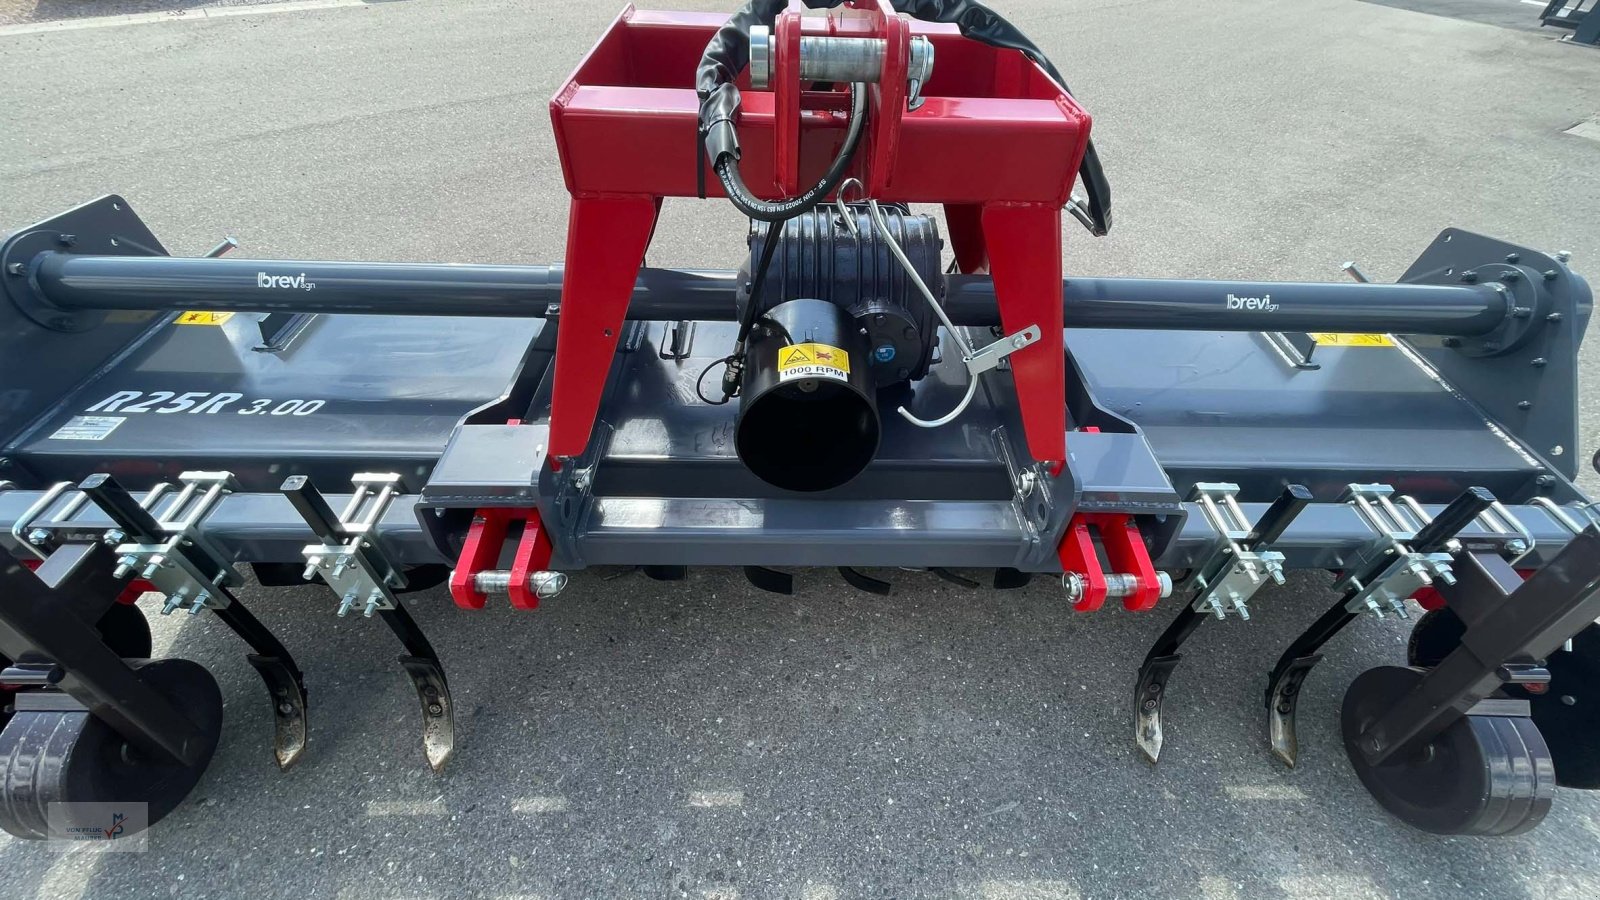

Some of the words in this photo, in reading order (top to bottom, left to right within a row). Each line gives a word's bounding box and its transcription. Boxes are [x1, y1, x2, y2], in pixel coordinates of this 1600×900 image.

[803, 189, 814, 201] DIN
[785, 198, 803, 210] 20022
[257, 271, 306, 289] brevi
[1226, 293, 1271, 310] brevi
[784, 366, 811, 377] 1000
[816, 366, 844, 378] RPM
[84, 390, 243, 415] R25R
[237, 398, 326, 416] 3.00
